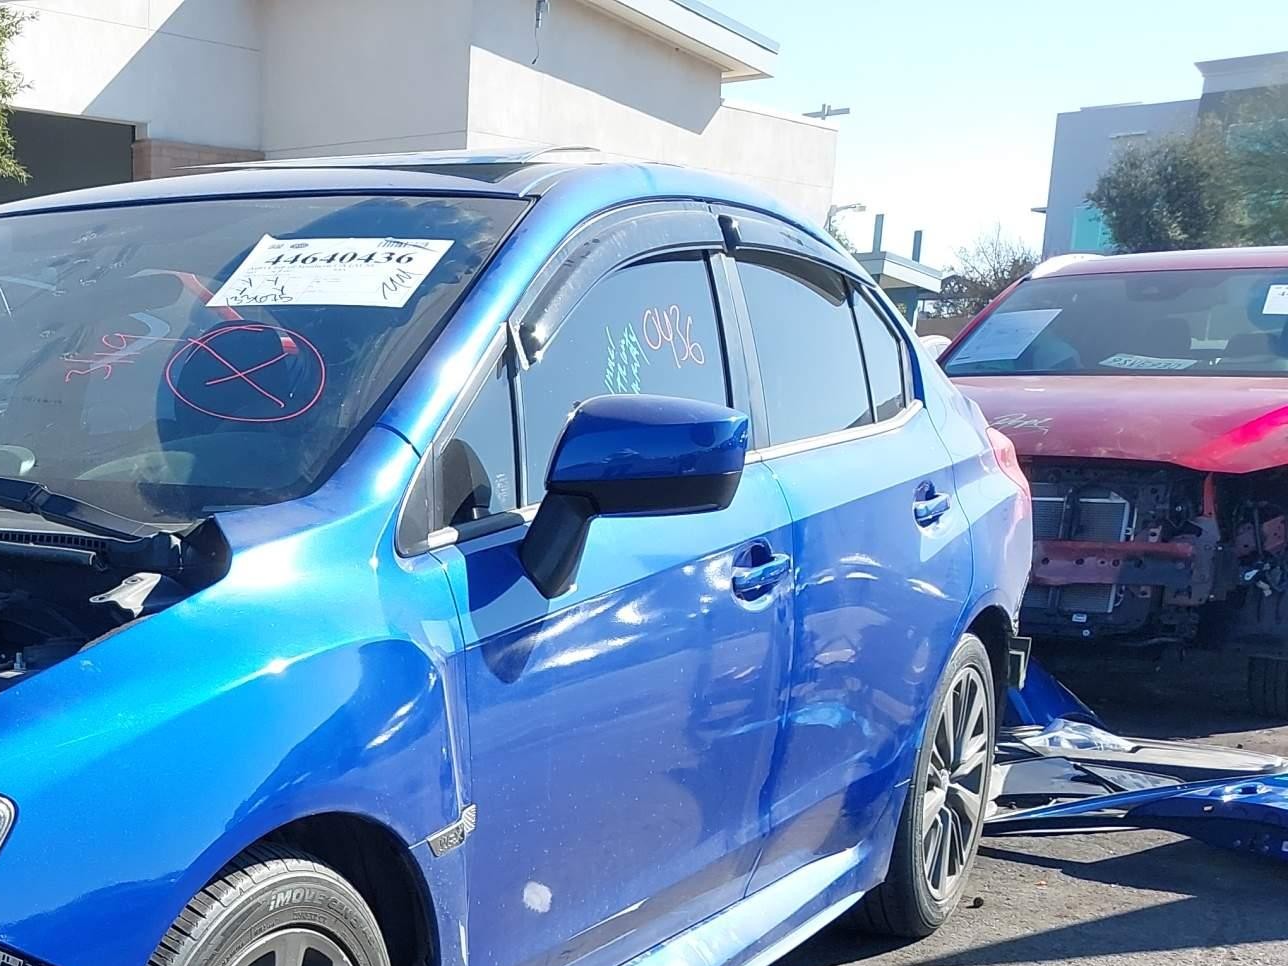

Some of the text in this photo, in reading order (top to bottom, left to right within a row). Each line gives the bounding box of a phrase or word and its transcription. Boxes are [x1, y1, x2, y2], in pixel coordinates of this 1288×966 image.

[264, 251, 417, 266] 44640436
[643, 304, 705, 368] 0436
[268, 887, 326, 911] iMOVE
